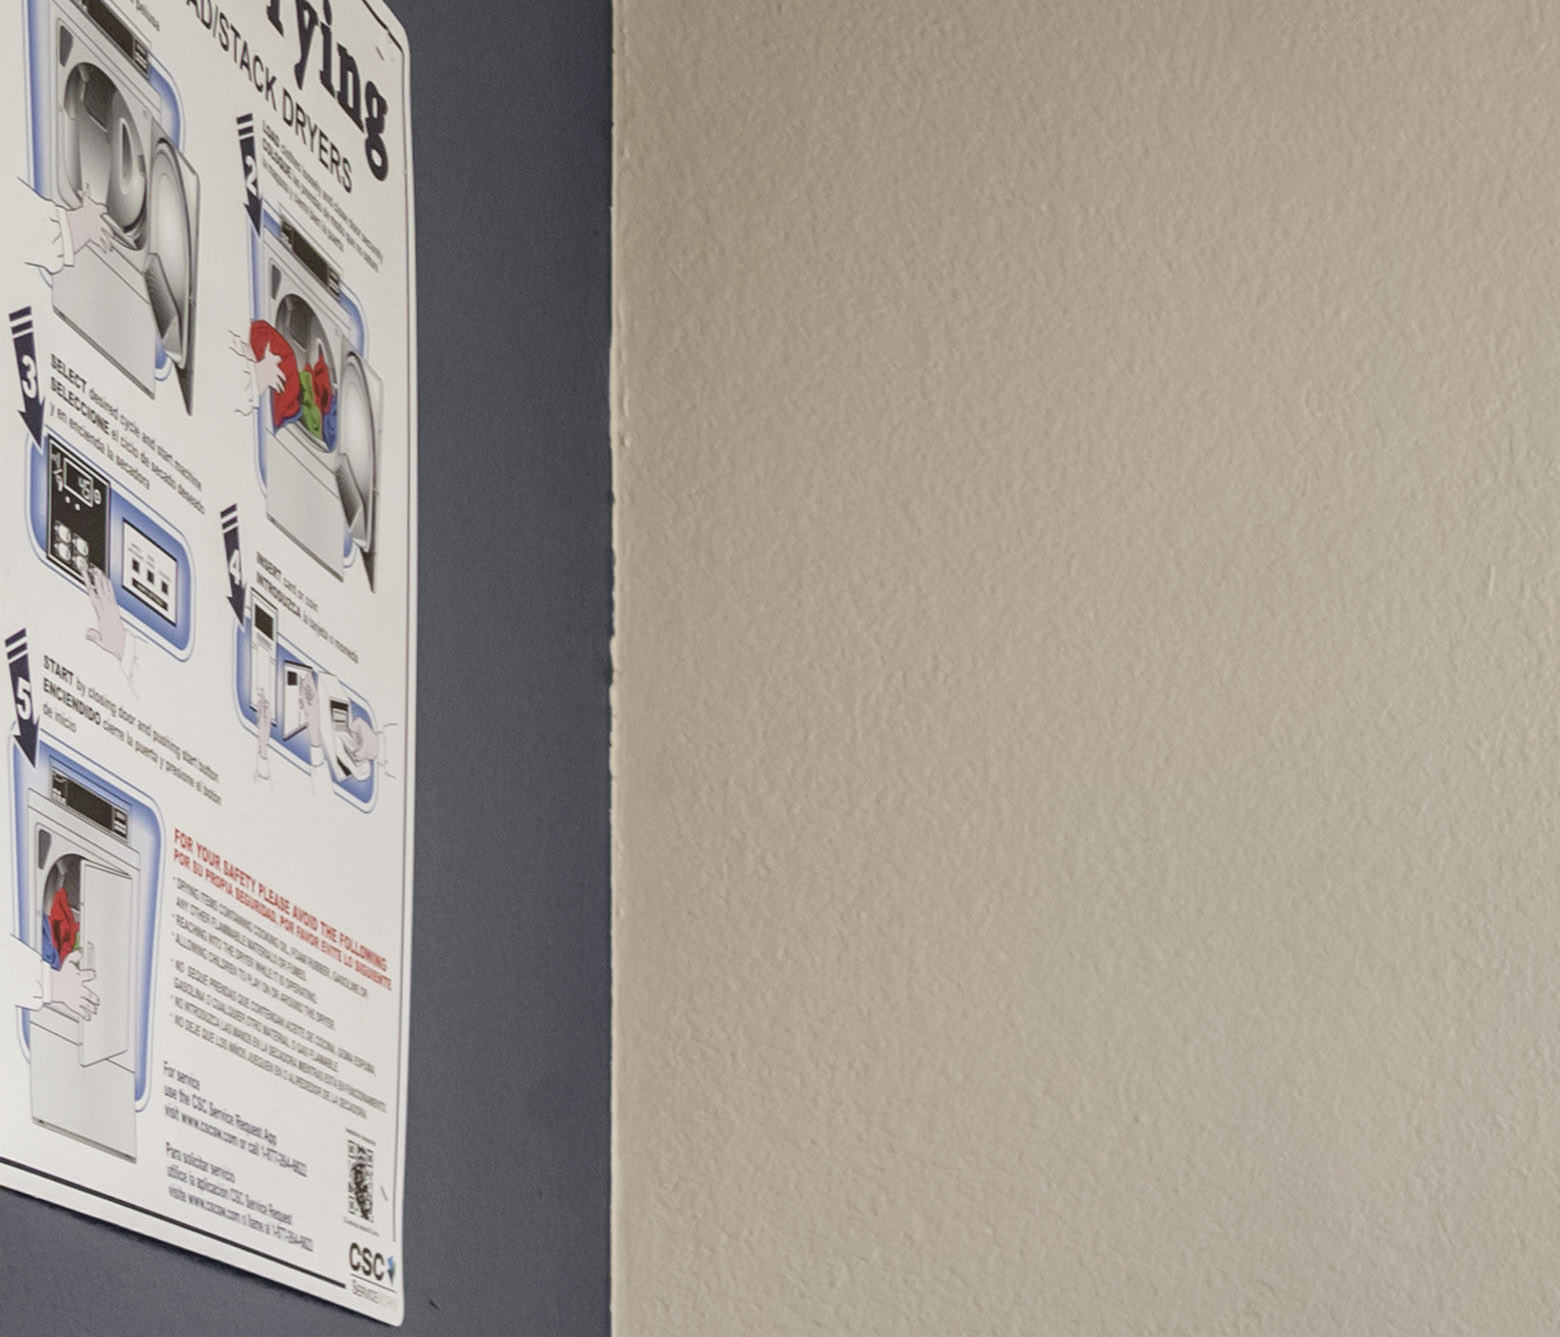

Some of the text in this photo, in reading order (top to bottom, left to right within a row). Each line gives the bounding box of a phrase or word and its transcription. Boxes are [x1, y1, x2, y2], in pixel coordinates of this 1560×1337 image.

[282, 88, 352, 193] DRYERS
[246, 155, 259, 194] 2
[19, 354, 39, 398] 3
[50, 353, 87, 392] SELECT
[43, 654, 73, 684] START
[14, 676, 33, 719] 5
[173, 827, 386, 971] FOR YOUR SAFETY PLEASE AVOID THE FOLLOWING
[349, 1242, 384, 1281] CSC
